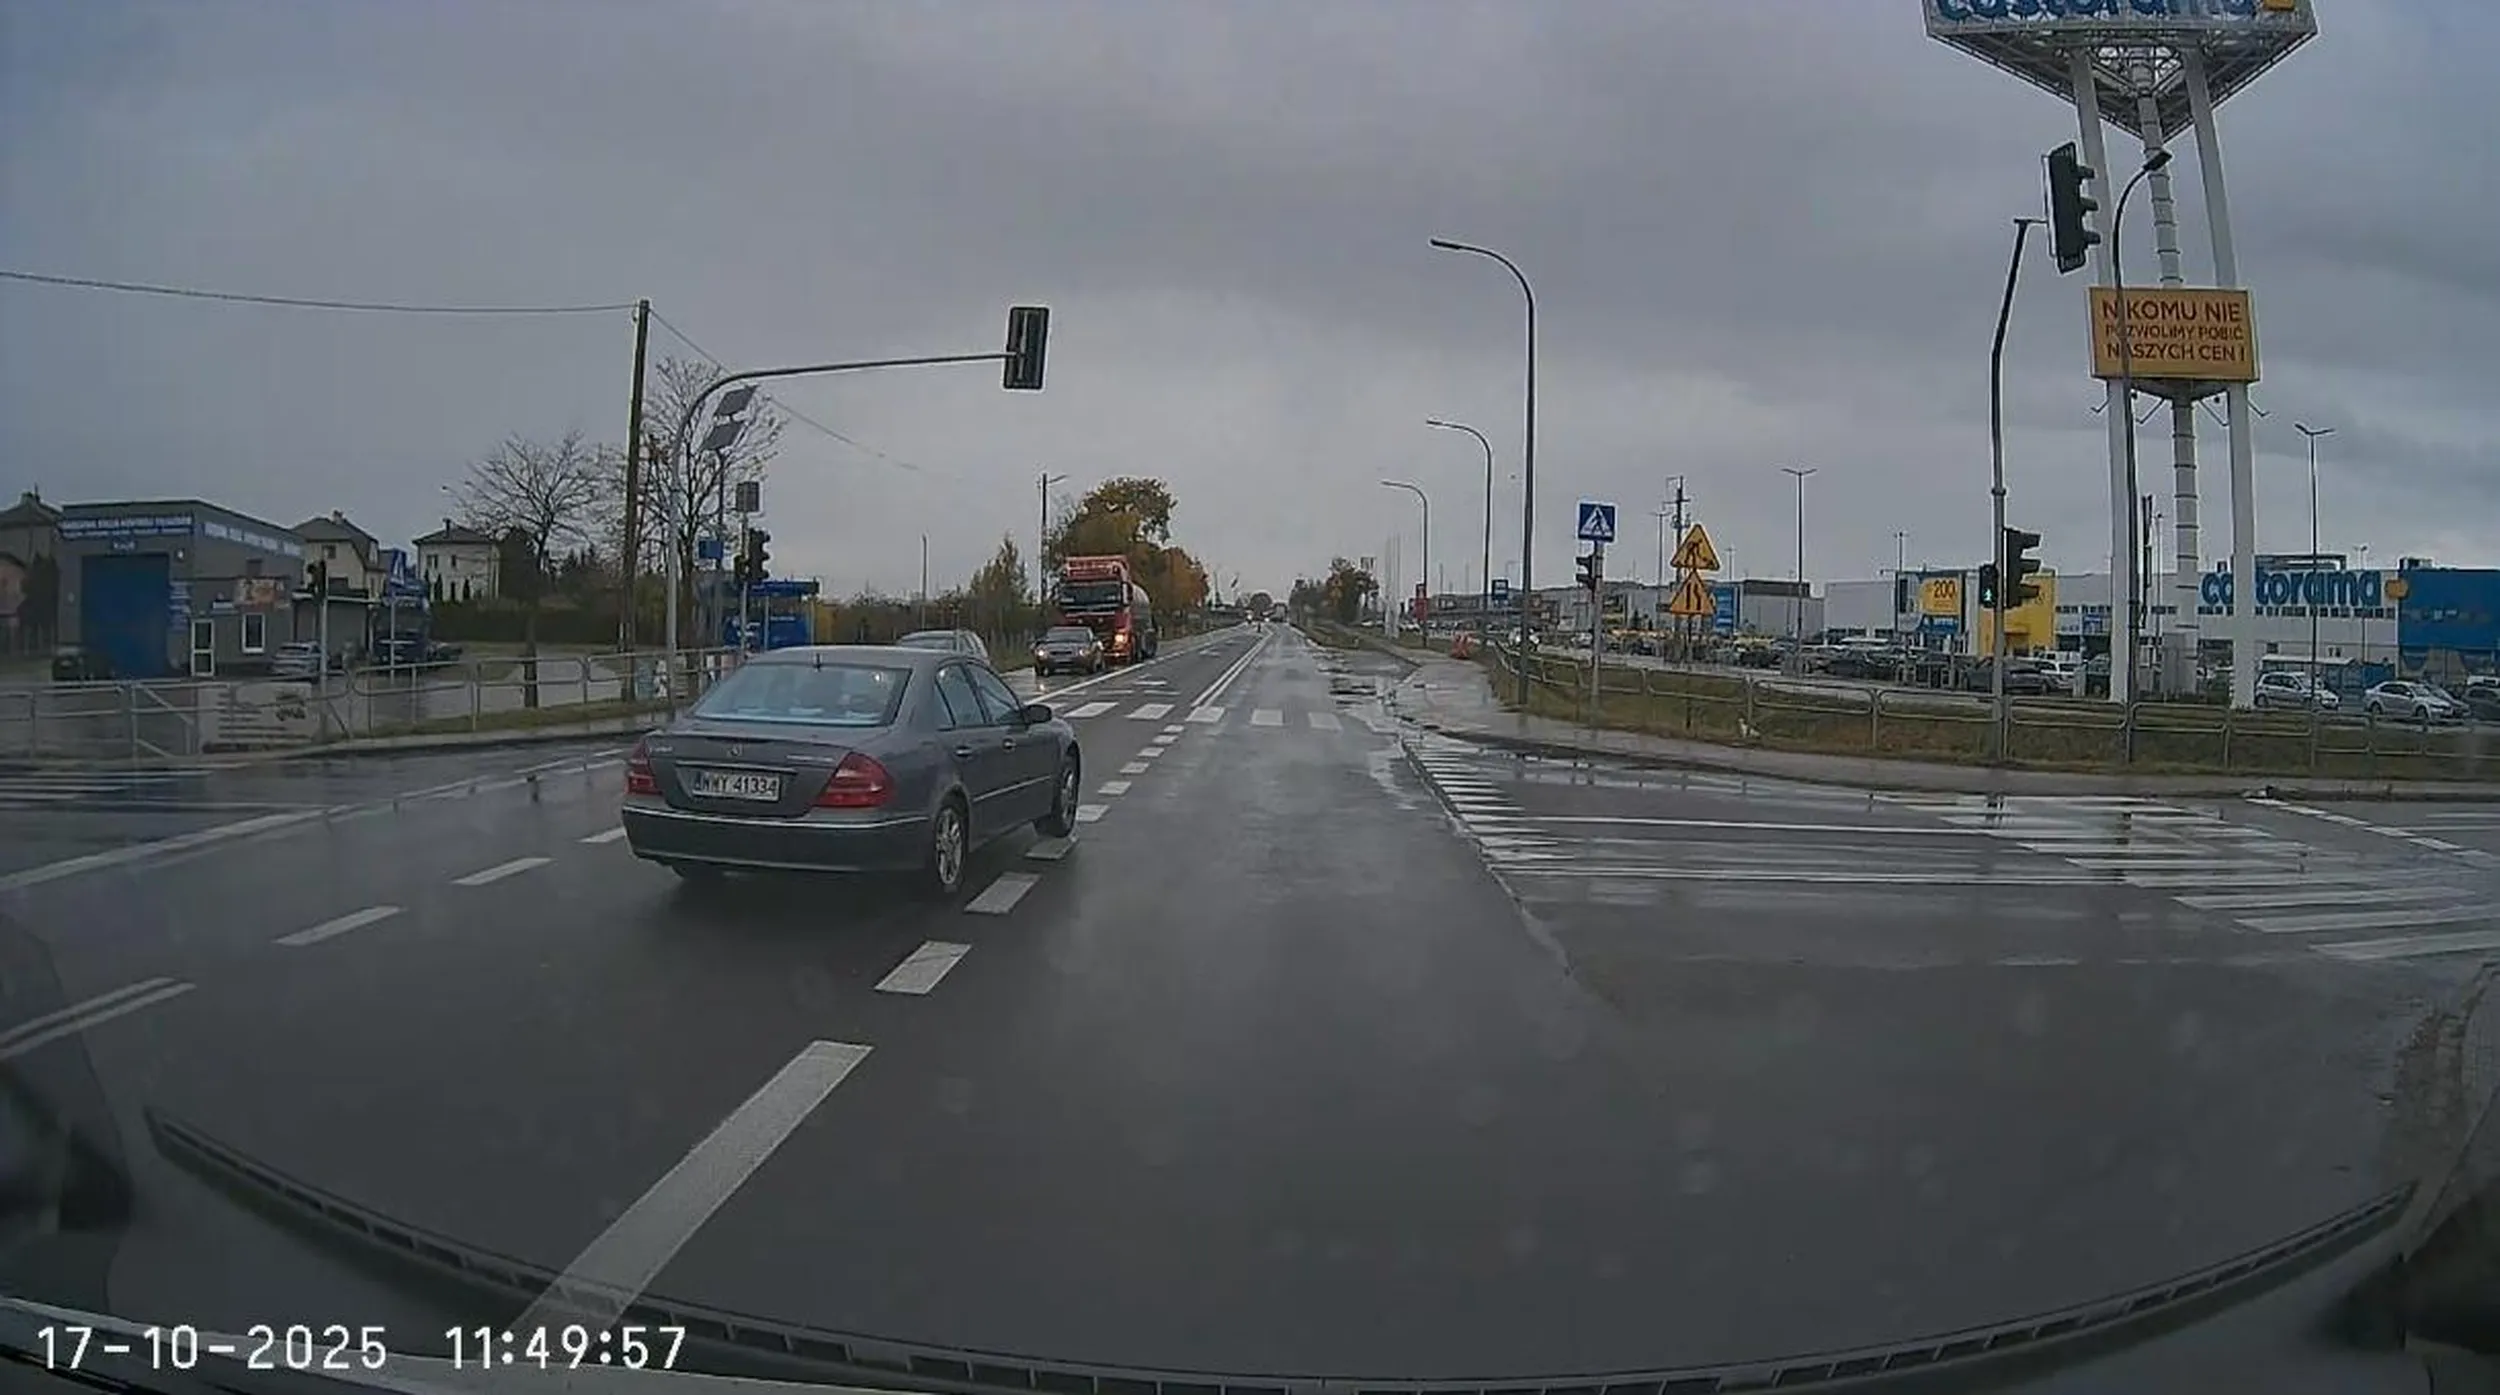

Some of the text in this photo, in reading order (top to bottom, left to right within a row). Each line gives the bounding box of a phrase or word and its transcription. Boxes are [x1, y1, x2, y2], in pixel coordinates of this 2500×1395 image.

[2102, 300, 2242, 322] NKOMU NIE
[2106, 324, 2194, 339] PZWOLIMY
[2199, 345, 2236, 361] CEN
[2202, 567, 2381, 606] catorama
